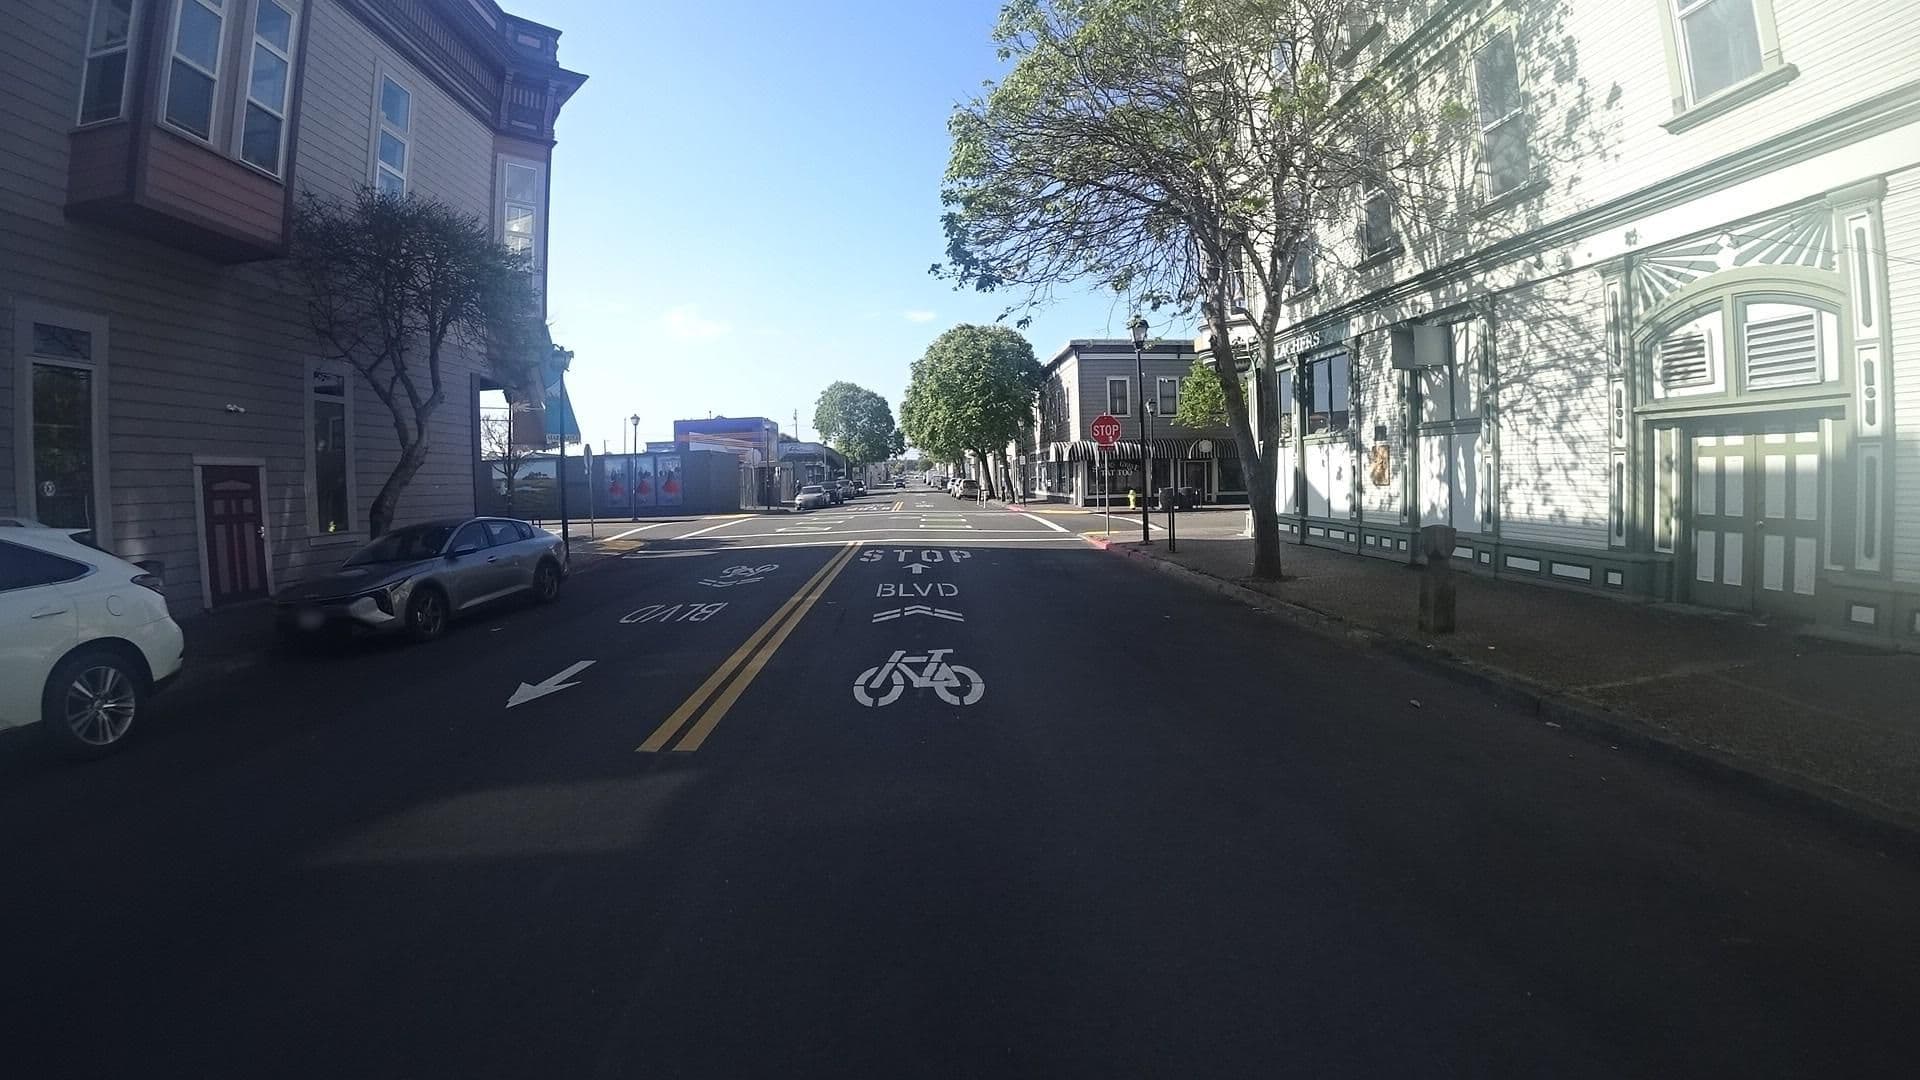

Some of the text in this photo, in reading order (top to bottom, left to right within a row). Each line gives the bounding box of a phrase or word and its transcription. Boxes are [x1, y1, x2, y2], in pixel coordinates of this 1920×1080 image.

[1093, 424, 1119, 436] STOP
[859, 549, 972, 563] STOP
[876, 583, 959, 598] BLVD
[619, 602, 729, 624] BLVD
